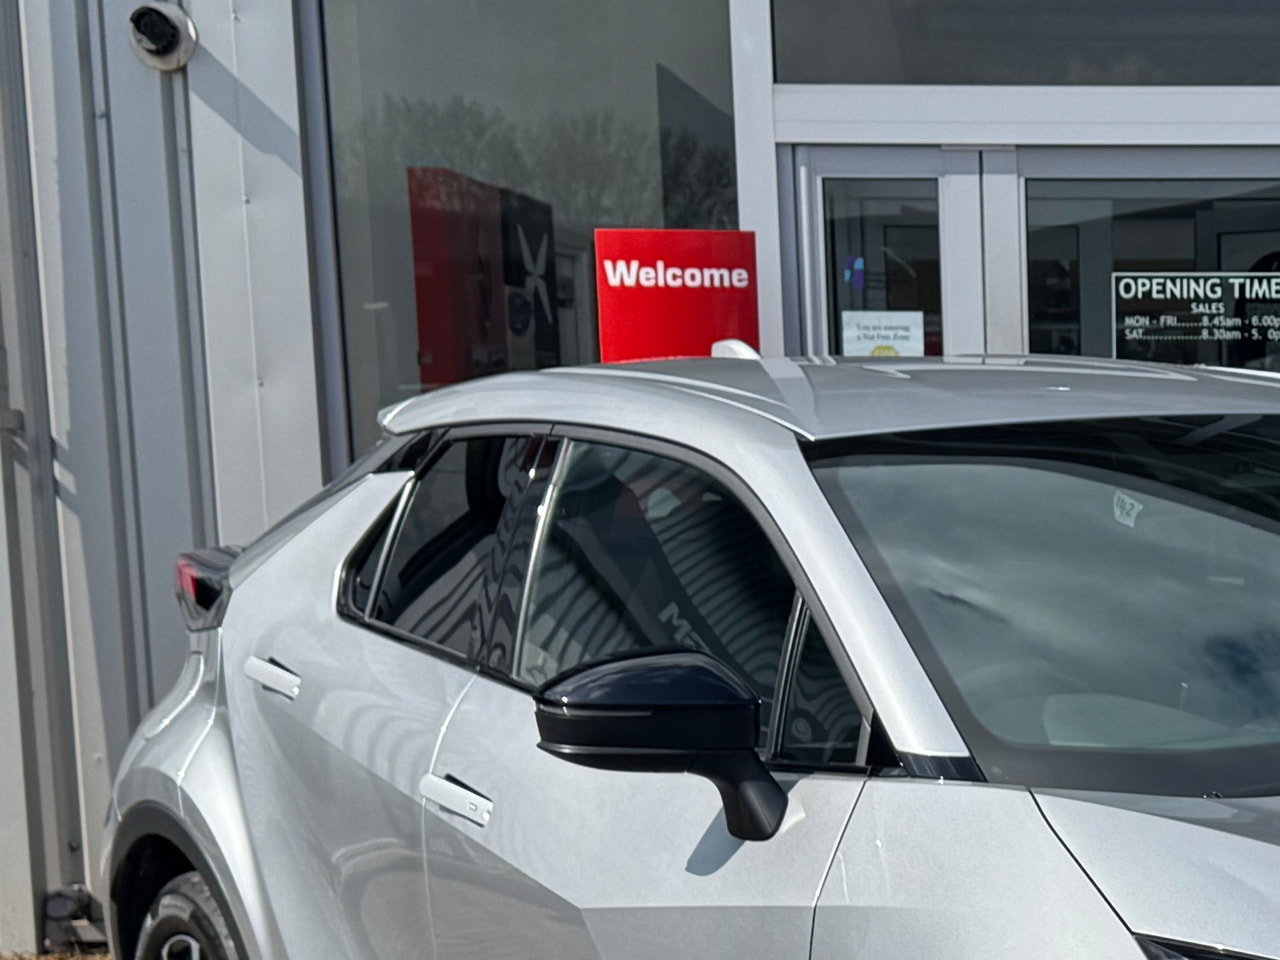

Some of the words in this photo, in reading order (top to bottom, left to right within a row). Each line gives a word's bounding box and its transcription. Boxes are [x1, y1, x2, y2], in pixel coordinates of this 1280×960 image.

[602, 259, 749, 288] Welcome
[1118, 277, 1223, 300] OPENING
[1190, 302, 1225, 314] SALES
[1123, 315, 1150, 328] MON
